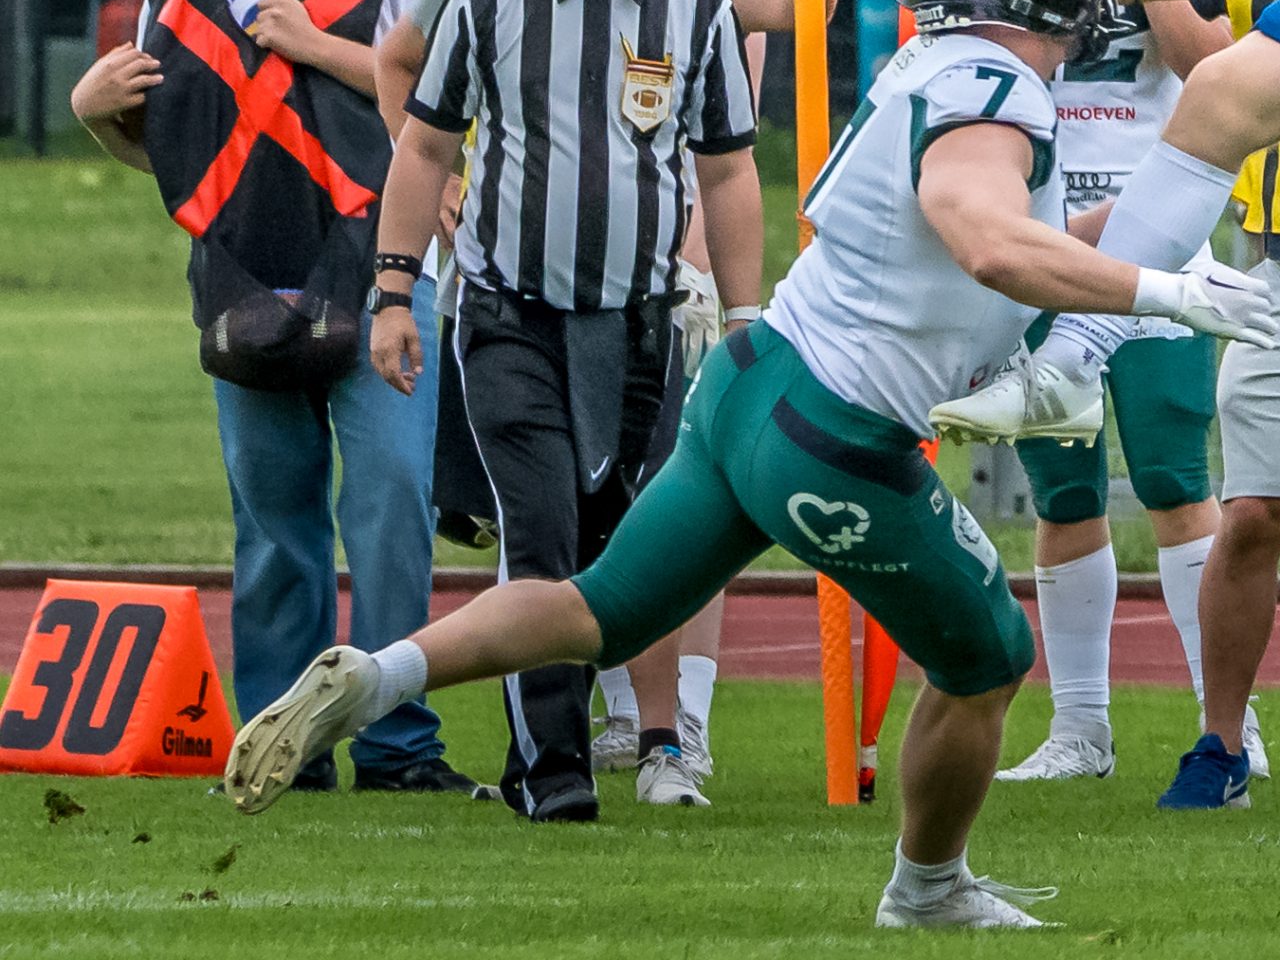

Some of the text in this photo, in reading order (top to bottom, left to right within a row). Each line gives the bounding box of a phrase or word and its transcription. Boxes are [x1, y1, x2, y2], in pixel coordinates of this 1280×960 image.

[975, 65, 1018, 119] 7
[0, 598, 167, 756] 30
[162, 725, 213, 758] Gilman
